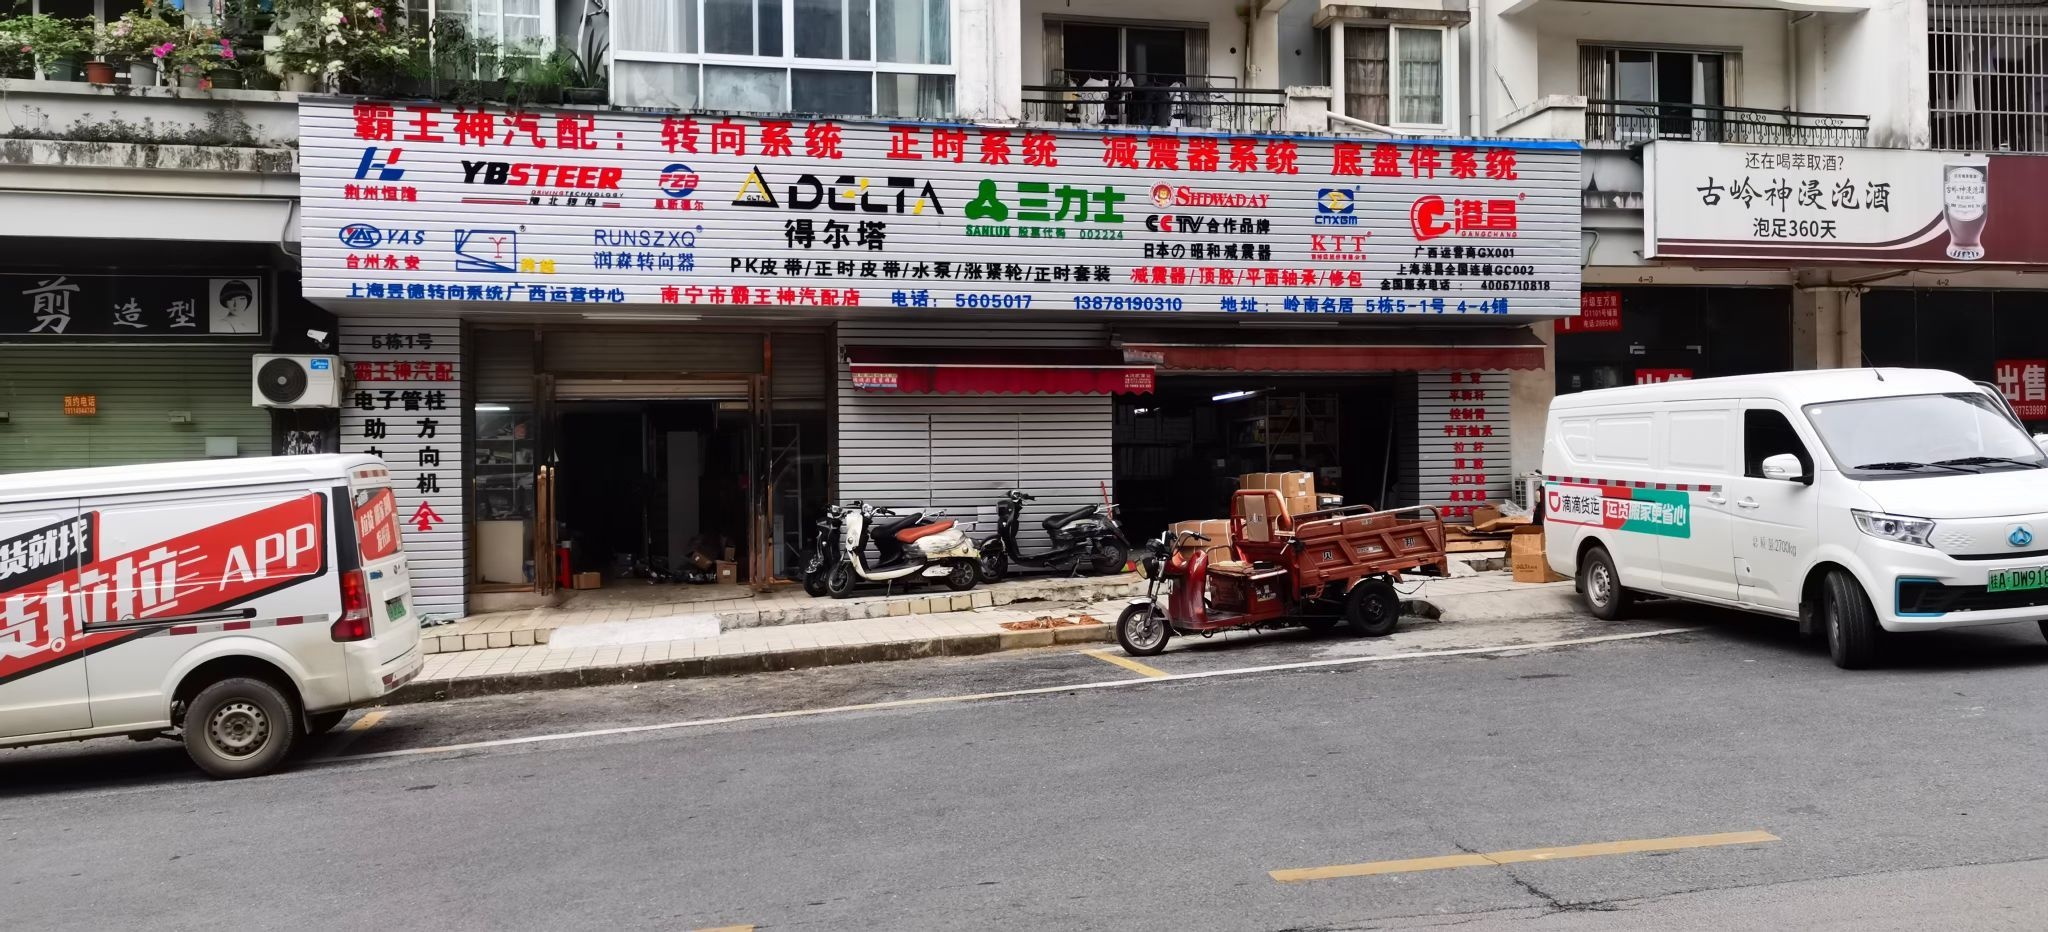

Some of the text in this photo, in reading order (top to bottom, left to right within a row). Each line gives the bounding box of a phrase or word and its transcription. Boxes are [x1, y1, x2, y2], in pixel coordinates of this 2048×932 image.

[661, 114, 843, 160] 转向系统
[886, 125, 1058, 168] 正时系统
[1101, 134, 1299, 175] 减震器系统
[1331, 143, 1518, 181] 底盘件系统
[461, 160, 623, 190] YBSTEER
[344, 184, 417, 202] 荆州恒隆
[1018, 181, 1126, 223] 三力士
[1696, 175, 1891, 213] 古岭神浸泡酒
[1455, 198, 1517, 234] 港昌
[387, 229, 425, 245] YAS
[594, 229, 695, 248] RUNSZXQ
[784, 218, 886, 251] 得尔塔
[1079, 229, 1124, 240] 002224
[1752, 217, 1837, 239] 泡足360天
[1144, 241, 1271, 261] 日本の昭和减震器
[1311, 234, 1366, 252] KTT
[346, 253, 420, 270] 台州永安
[594, 252, 695, 272] 润森转向器
[660, 284, 860, 307] 南宁市霸王神汽配店
[1481, 280, 1550, 291] 4006710818
[22, 276, 197, 334] 剪 造型
[955, 295, 1032, 308] 5605017
[1073, 295, 1183, 312] 13878190310
[1283, 296, 1354, 314] 岭南名居
[1366, 298, 1445, 315] 5栋5-1号
[372, 333, 433, 349] 5栋1号
[354, 361, 454, 382] 霸王神汽配
[1997, 364, 2046, 401] 出售
[355, 390, 446, 411] 电子管柱
[2012, 405, 2047, 415] 977539987
[416, 418, 440, 494] 方向机
[1562, 495, 1600, 515] 滴滴货运
[408, 501, 444, 531] 全
[218, 522, 316, 592] APP
